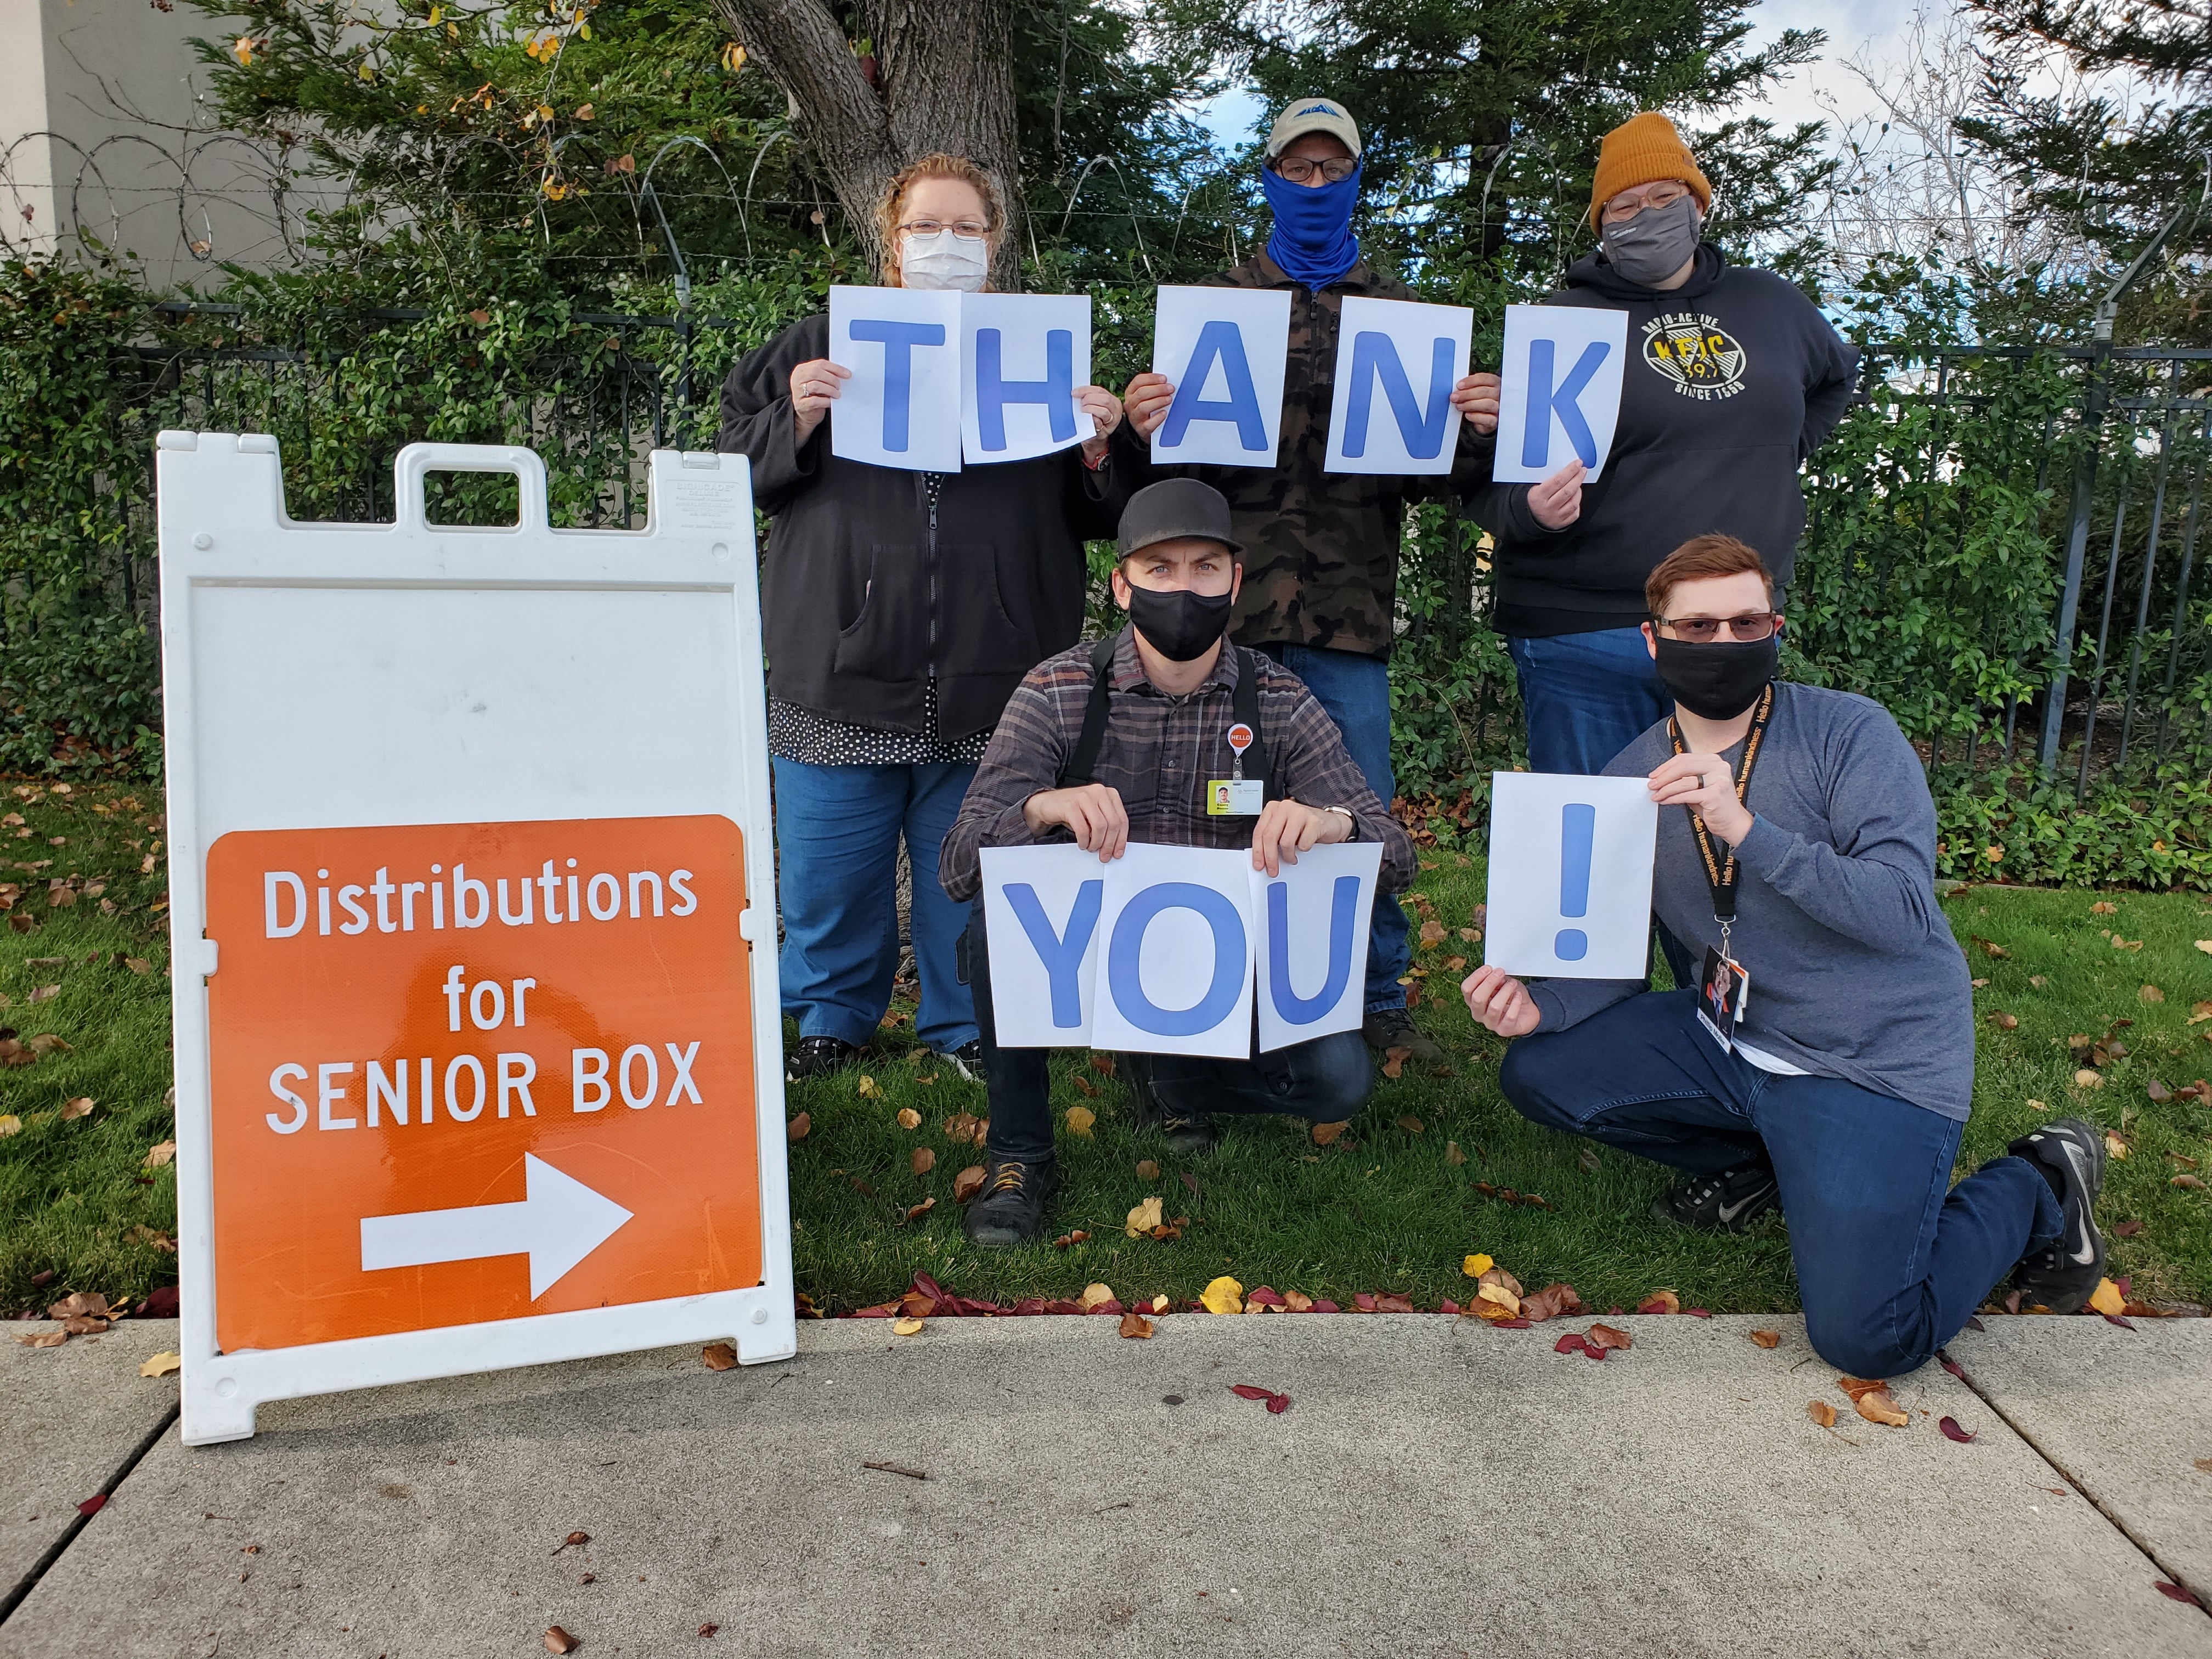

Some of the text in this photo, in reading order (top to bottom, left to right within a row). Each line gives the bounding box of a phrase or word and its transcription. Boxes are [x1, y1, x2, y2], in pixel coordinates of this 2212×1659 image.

[1674, 381, 1746, 400] SINCE 1959
[1756, 705, 1769, 723] Hello
[264, 857, 697, 939] Distributions
[1554, 803, 1596, 961] !
[1722, 866, 1733, 886] Hello
[1002, 875, 1361, 1037] YOU
[442, 965, 537, 1032] for
[265, 1041, 704, 1135] SENIOR BOX
